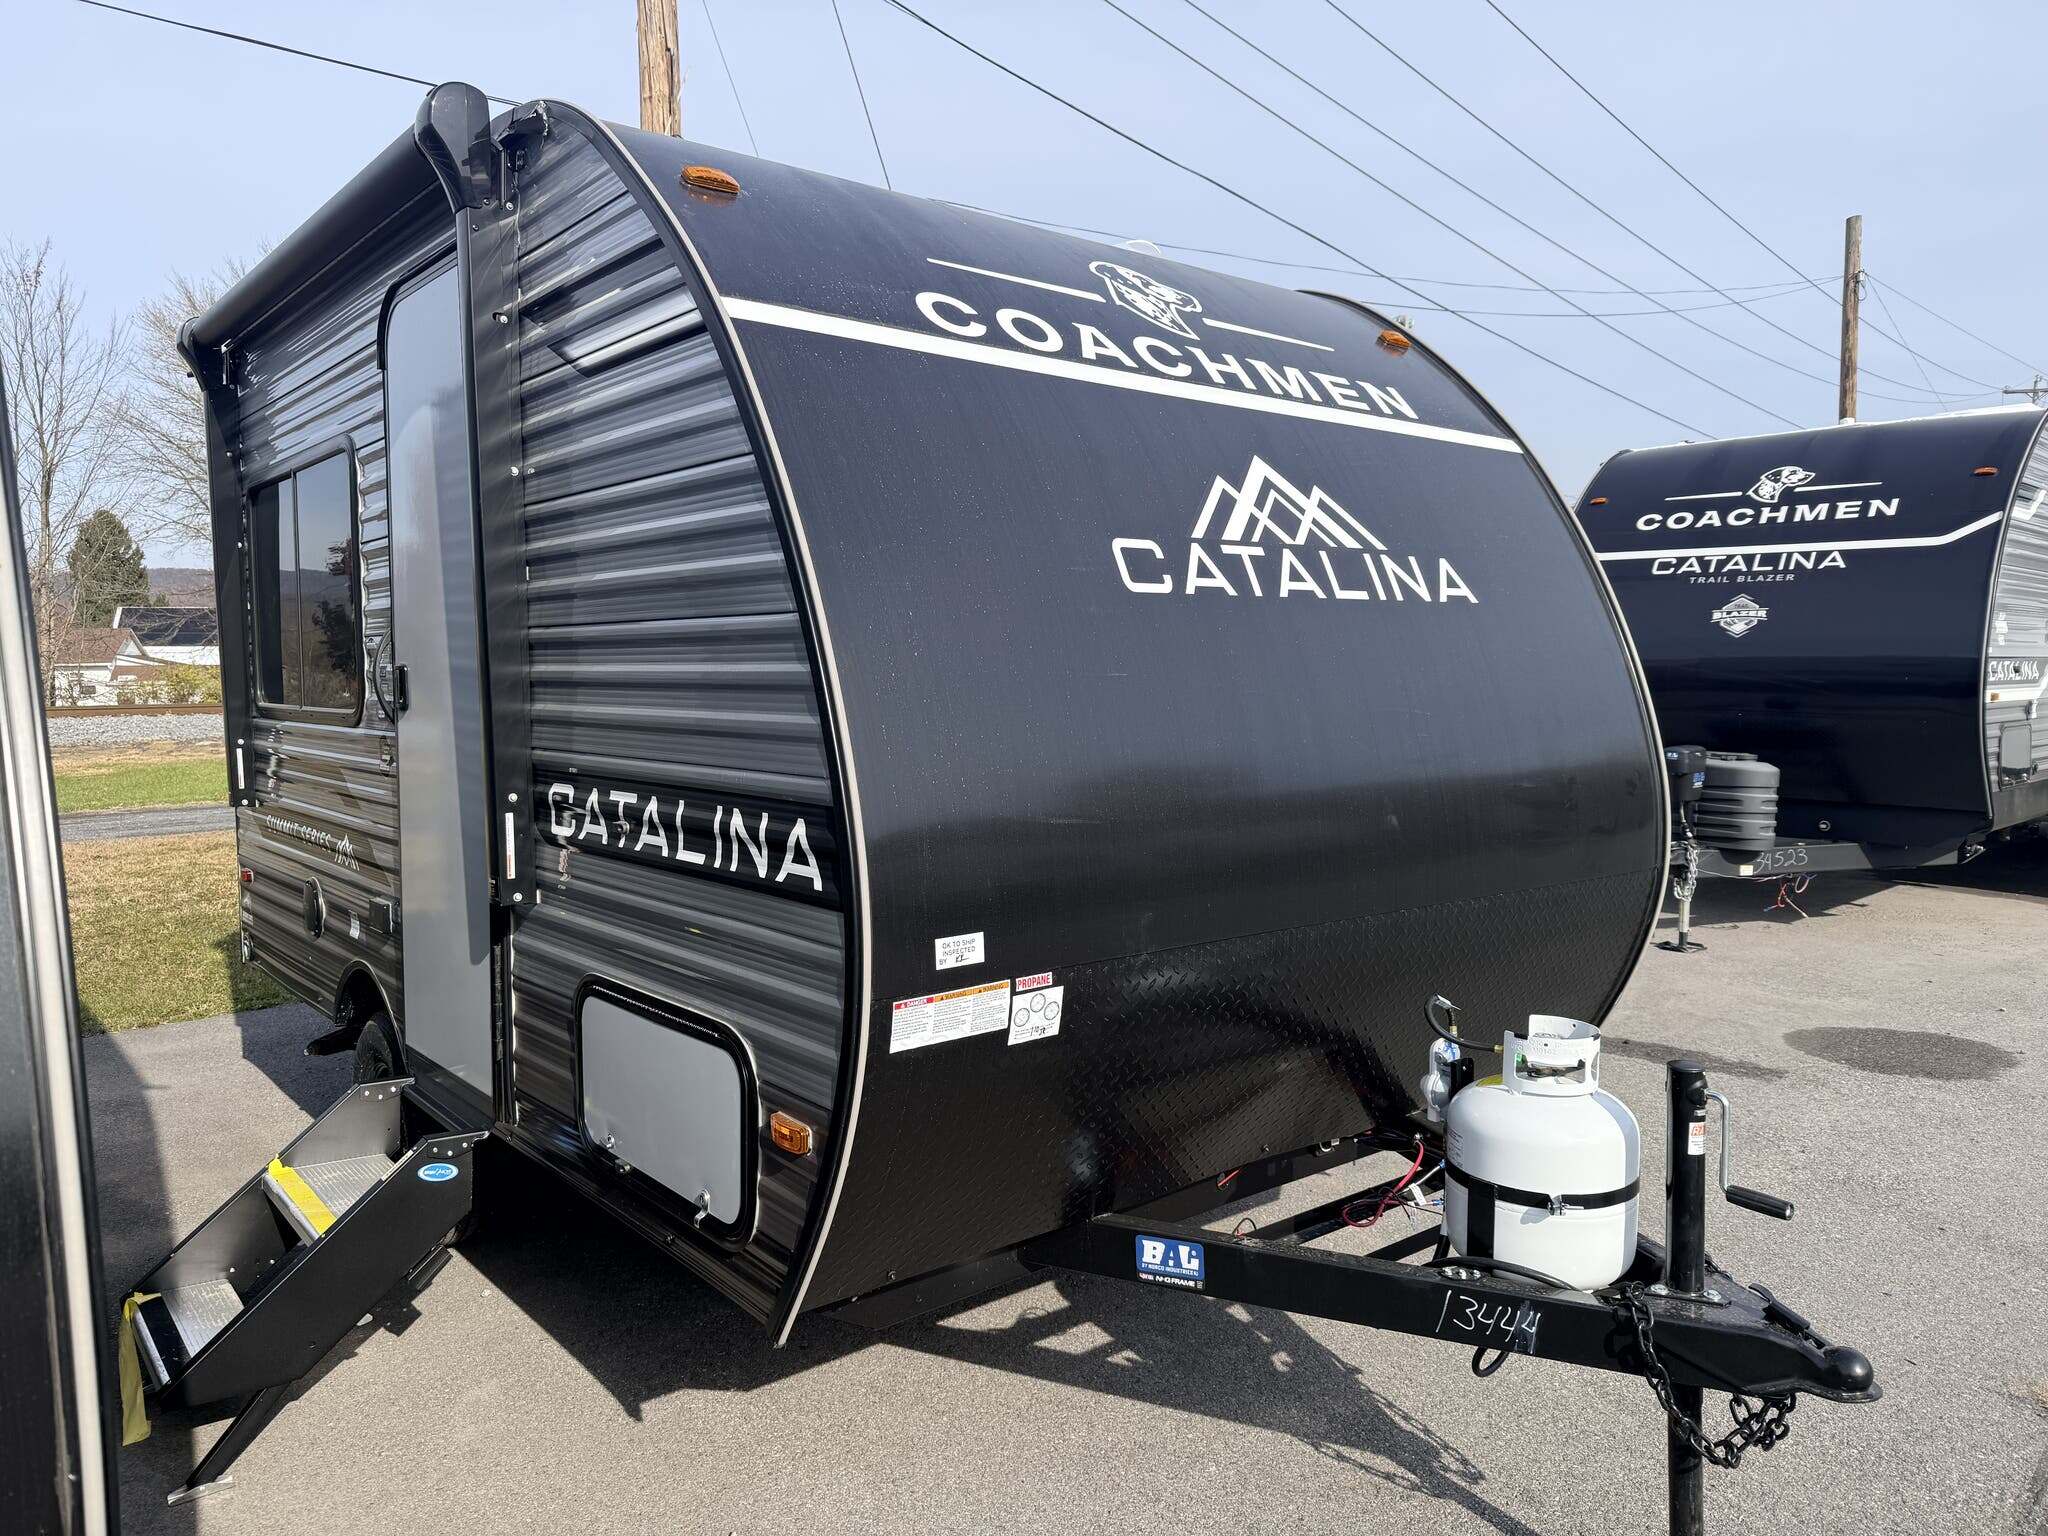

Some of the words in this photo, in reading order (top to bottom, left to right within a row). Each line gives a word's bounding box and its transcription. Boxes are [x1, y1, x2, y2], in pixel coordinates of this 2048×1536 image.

[914, 291, 1419, 420] COACHMEN
[1636, 498, 1900, 531] COACHMEN
[1111, 538, 1479, 604] CATALINA
[1651, 550, 1847, 575] CATALINA
[1689, 575, 1731, 585] TRAIL
[1736, 573, 1796, 584] BLAZER
[1712, 610, 1768, 620] BLAZER
[1988, 660, 2040, 682] CATALINA
[548, 783, 823, 891] CATALINA
[1753, 848, 1808, 873] 34523
[942, 946, 976, 957] INSPECTED
[1017, 974, 1051, 990] PROPANE
[1142, 1239, 1200, 1270] BAL
[1171, 1277, 1196, 1287] FRAME
[1436, 1290, 1541, 1354] 13444
